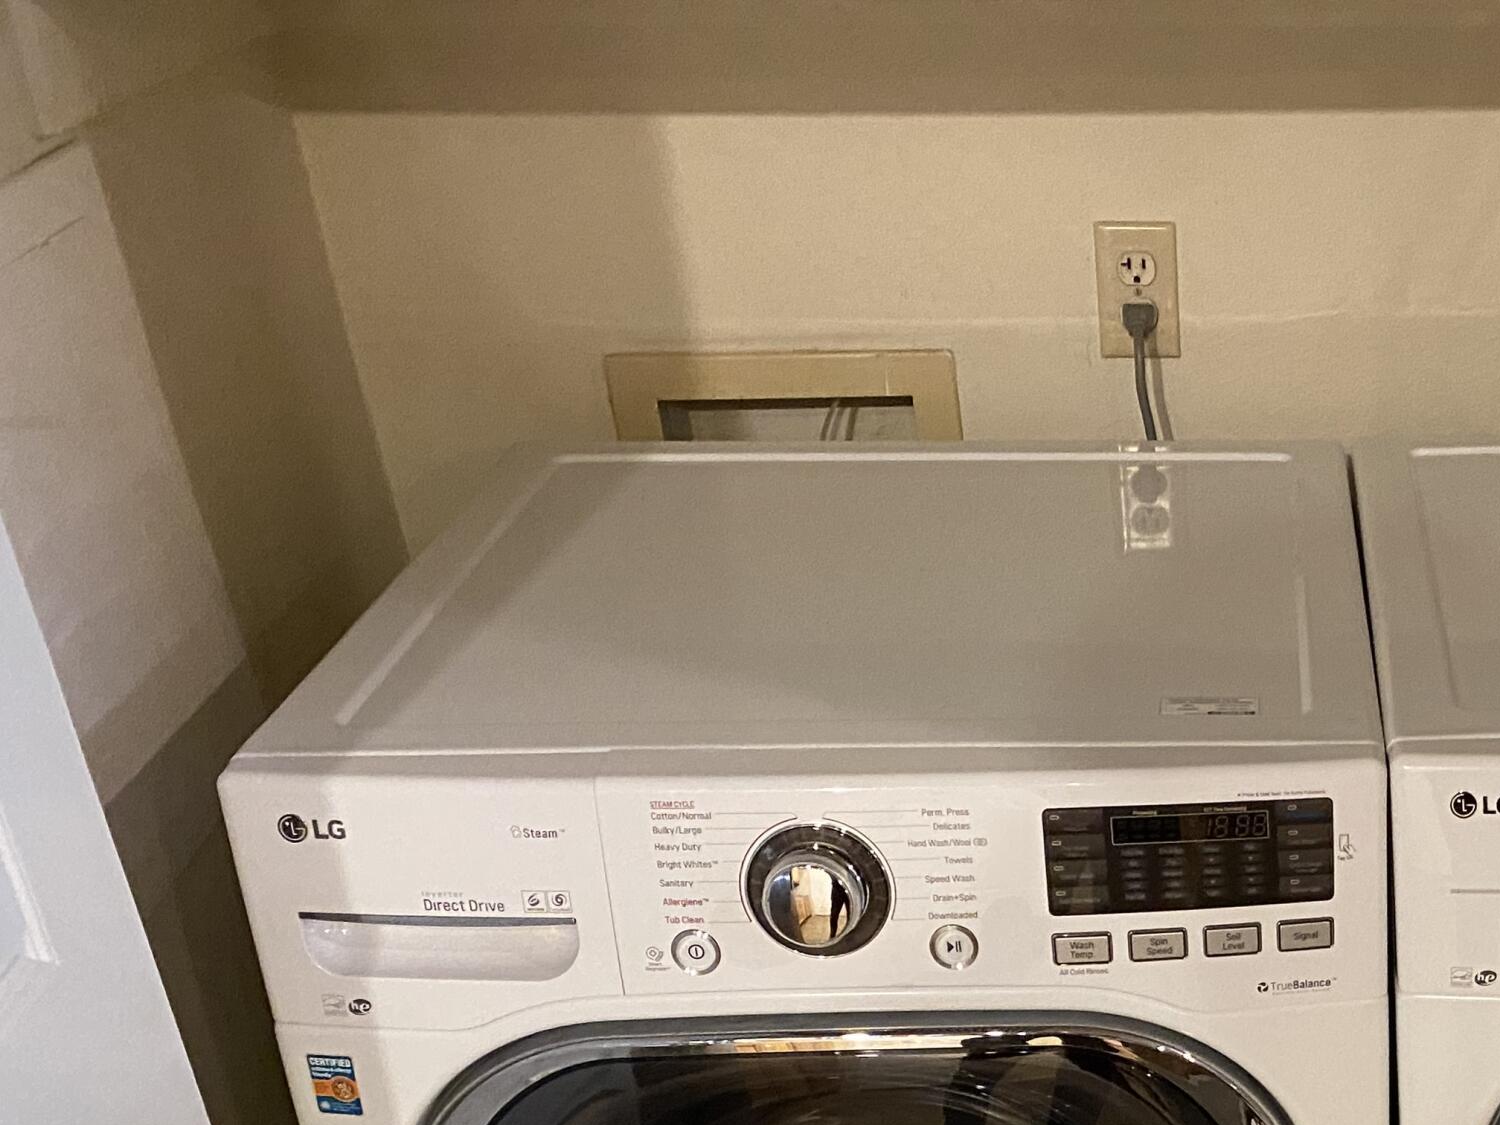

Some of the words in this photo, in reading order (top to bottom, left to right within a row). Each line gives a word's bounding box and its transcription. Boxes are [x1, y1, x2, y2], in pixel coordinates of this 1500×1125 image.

[650, 812, 712, 820] Cotton/Normal
[946, 808, 970, 816] Press
[311, 819, 346, 840] LG
[652, 826, 703, 836] Bulky/Large
[654, 843, 680, 852] Heavy
[681, 842, 702, 852] Duty
[656, 860, 682, 870] Bright
[951, 874, 976, 883] Wash
[659, 879, 694, 888] Sanitary
[423, 898, 466, 912] Direct
[468, 899, 505, 912] Drive
[664, 915, 680, 924] Tub
[681, 915, 705, 924] Clean
[1069, 941, 1095, 950] Wash
[1222, 942, 1245, 951] Level
